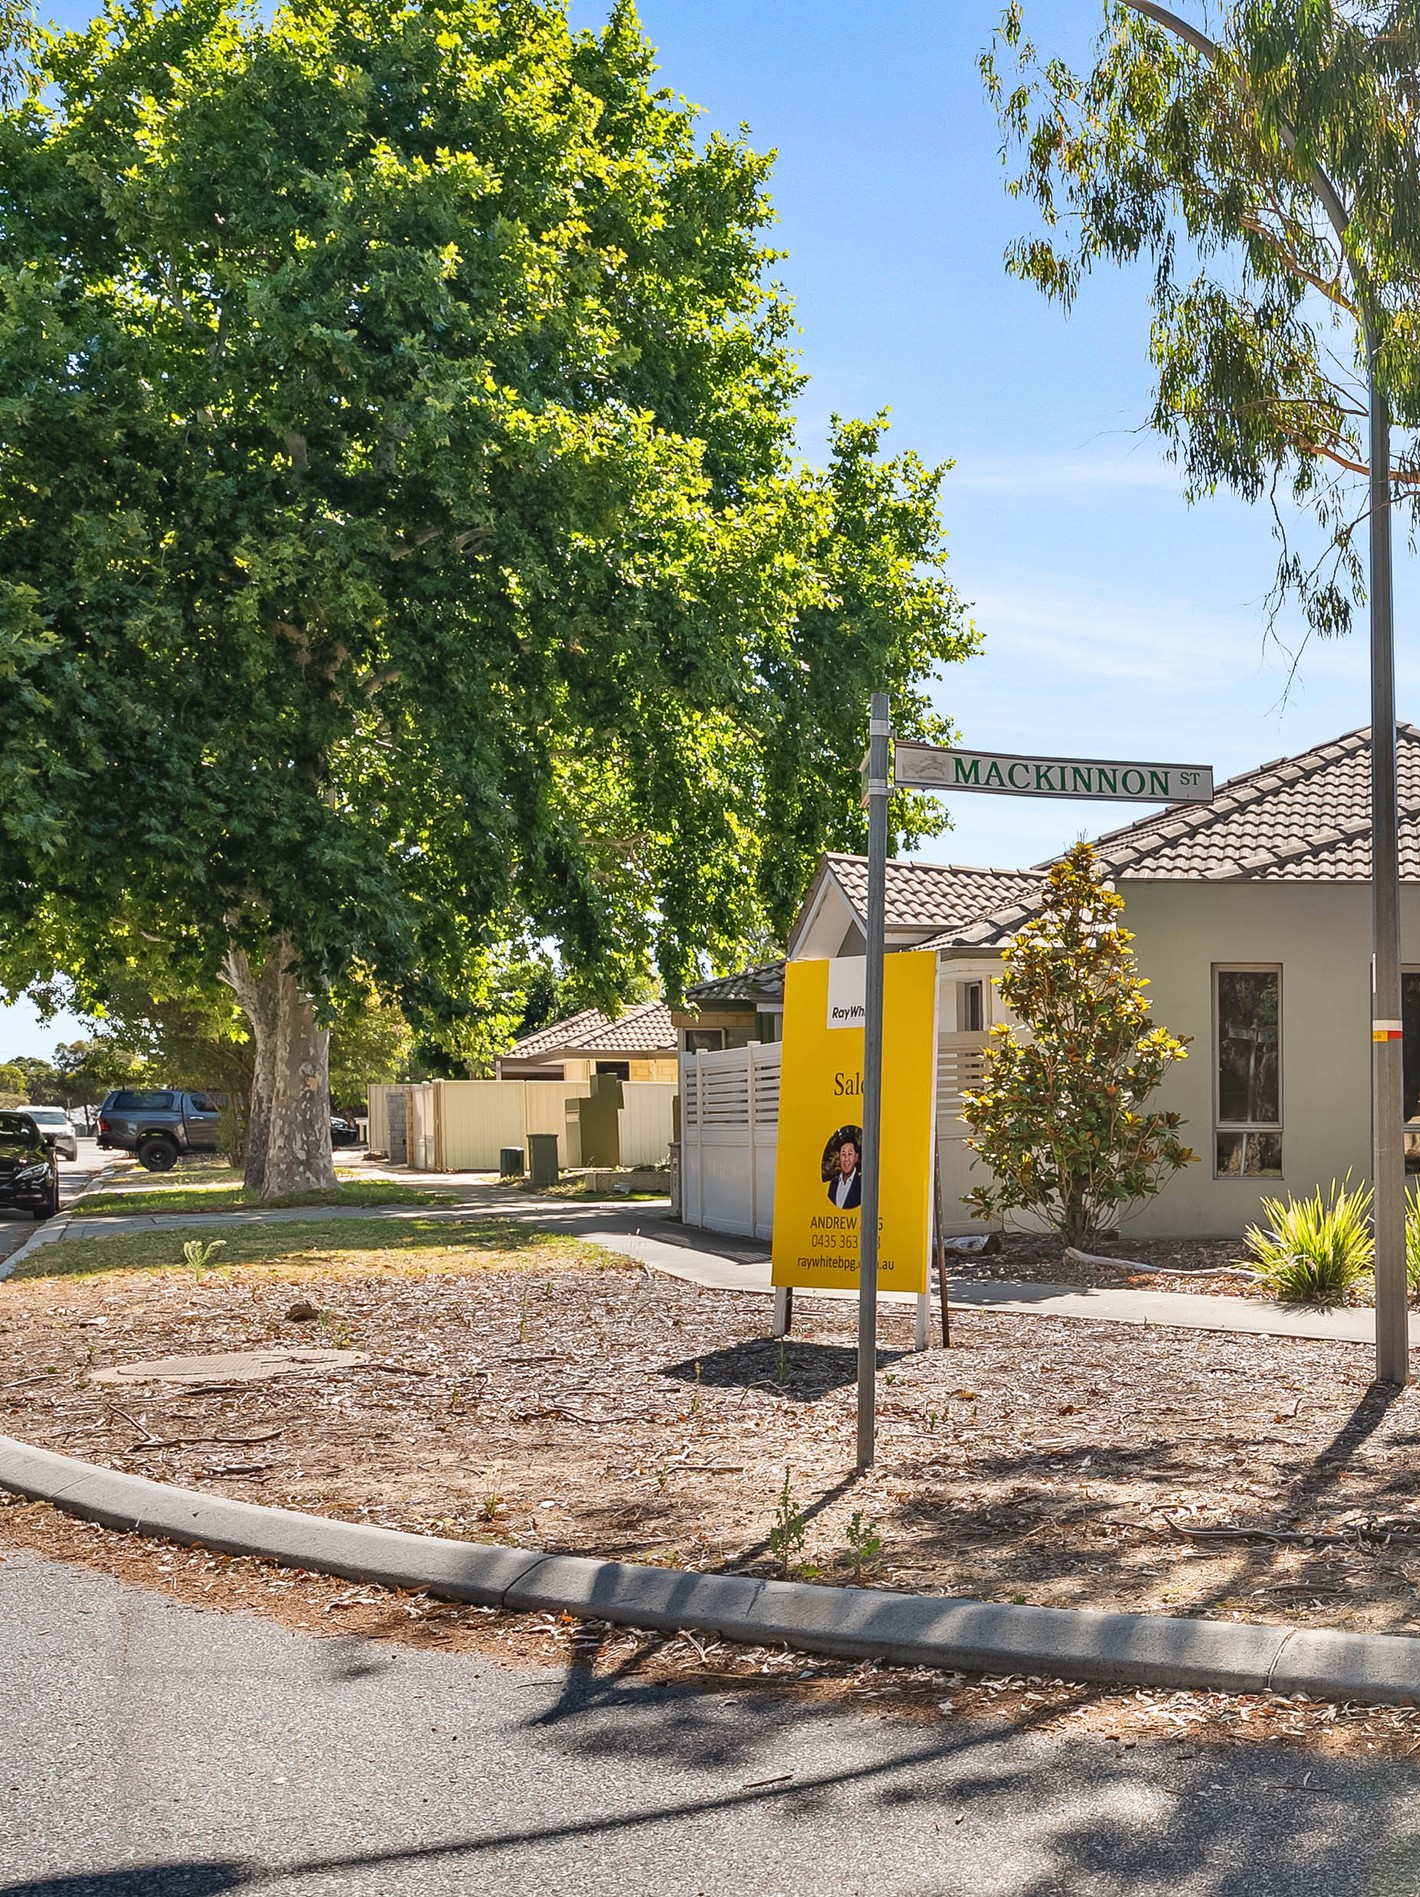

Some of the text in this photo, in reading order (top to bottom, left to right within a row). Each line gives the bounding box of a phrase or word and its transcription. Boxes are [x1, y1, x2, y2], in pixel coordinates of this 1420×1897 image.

[952, 757, 1201, 796] MACKINNON ST
[831, 1005, 865, 1021] RayWh
[809, 1216, 858, 1230] ANDREW
[811, 1234, 837, 1248] 0435
[839, 1234, 859, 1249] 363
[797, 1255, 895, 1272] raywhitebpg..au
